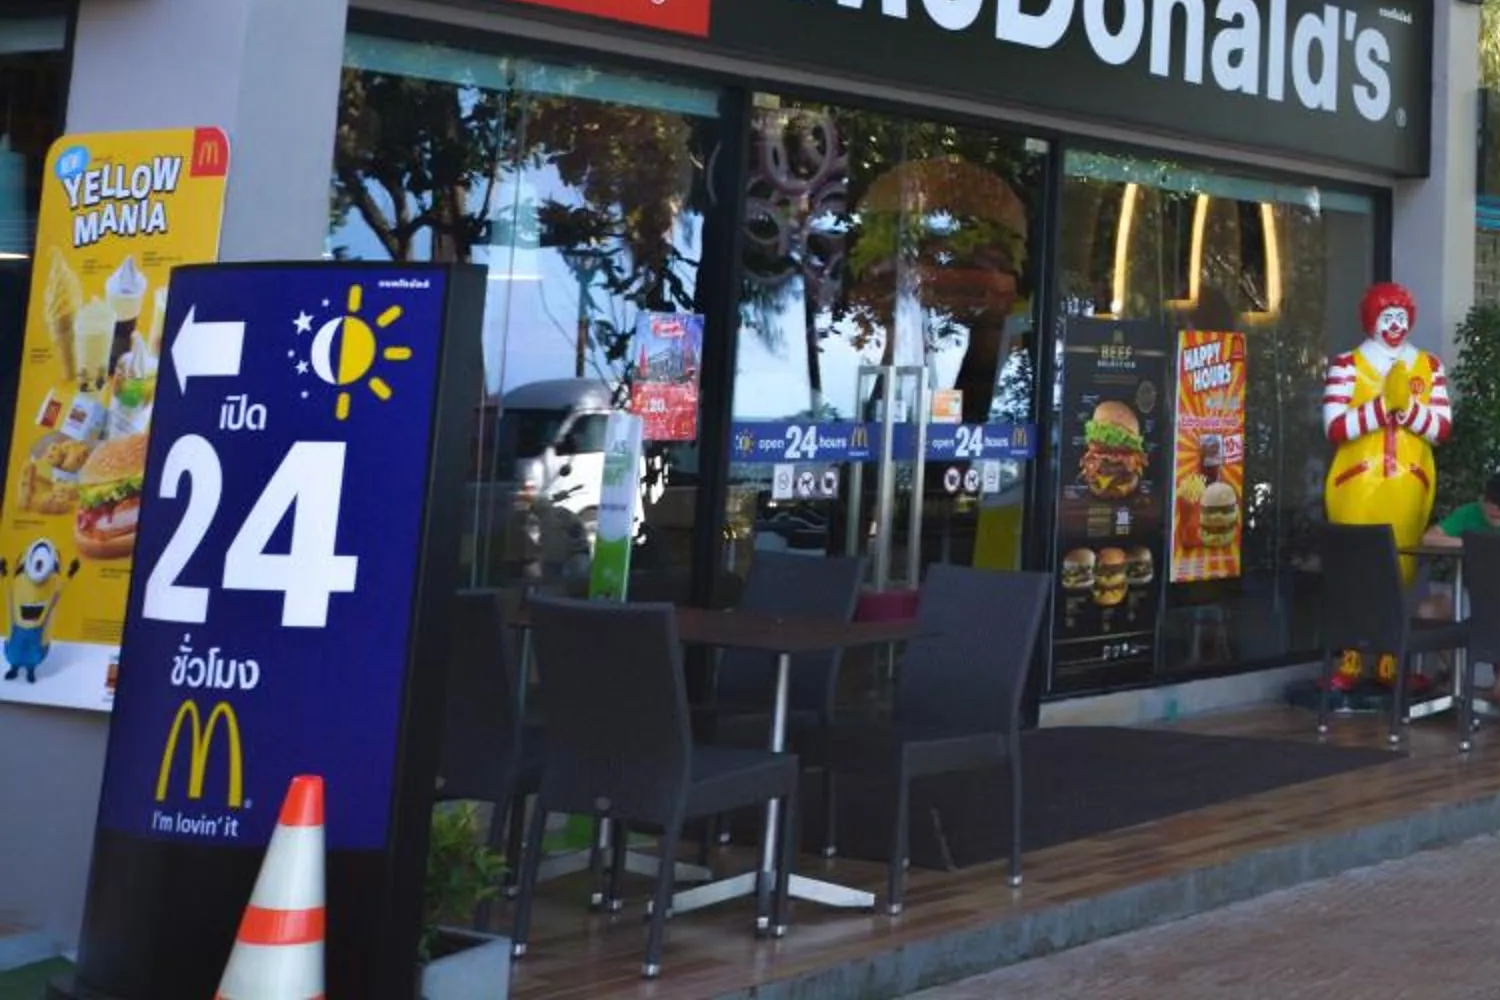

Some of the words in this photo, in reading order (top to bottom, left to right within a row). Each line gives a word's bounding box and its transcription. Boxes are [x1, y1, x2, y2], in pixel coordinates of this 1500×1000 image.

[63, 156, 182, 210] YELLOW
[74, 200, 168, 248] MANIA
[219, 393, 267, 430] เปิด
[758, 438, 785, 451] open
[784, 425, 818, 459] 24
[819, 434, 847, 448] hours
[955, 426, 984, 457] 24
[142, 433, 359, 627] 24
[171, 633, 260, 690] ชั่วโมง
[151, 810, 173, 832] I'm
[176, 811, 223, 836] lovin'
[223, 816, 240, 837] it
